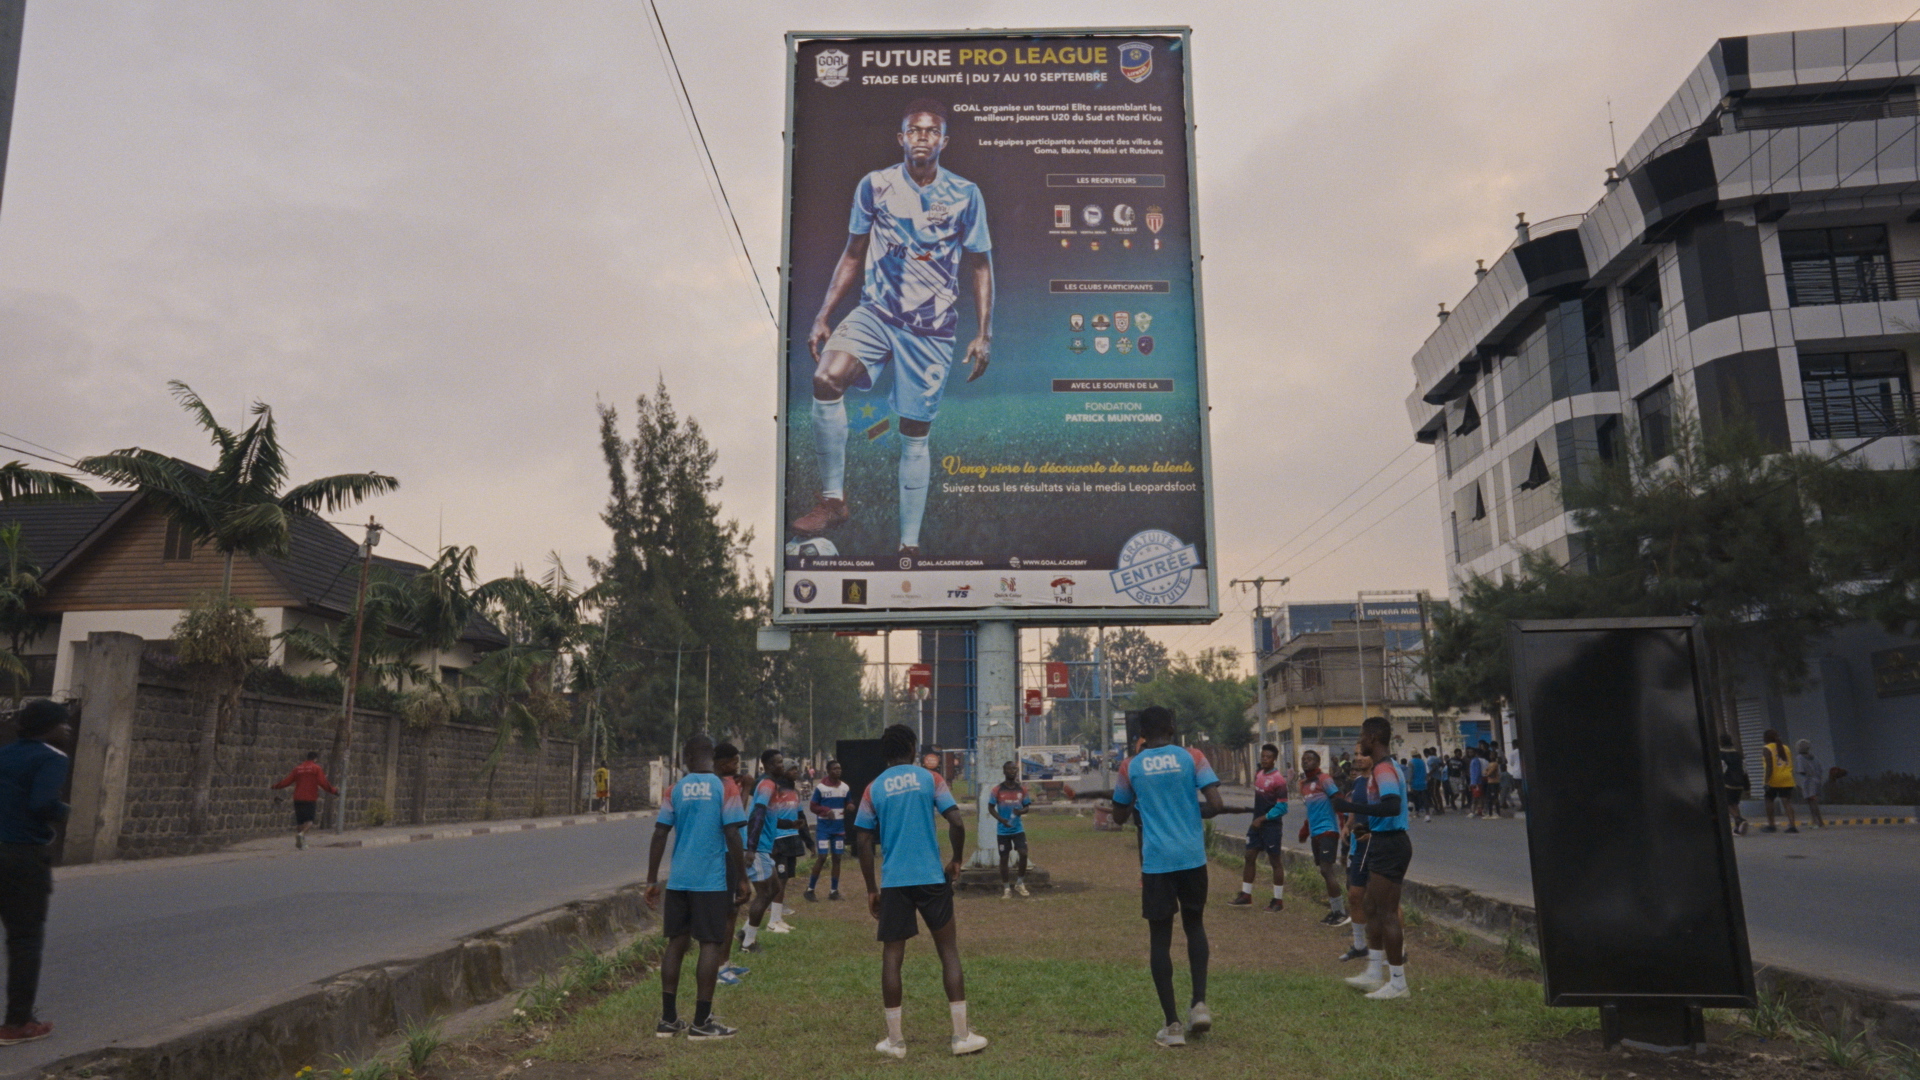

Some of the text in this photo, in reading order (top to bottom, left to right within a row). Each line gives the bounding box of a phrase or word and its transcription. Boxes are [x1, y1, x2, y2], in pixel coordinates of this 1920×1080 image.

[818, 55, 846, 66] GOAL
[861, 47, 1108, 67] FUTURE PRO LEAGUE
[862, 75, 899, 85] STADE
[902, 74, 917, 84] DE
[921, 72, 963, 83] L'UNITÉ
[972, 73, 990, 82] DU
[993, 73, 1000, 83] 7
[1003, 73, 1020, 82] AU
[1024, 72, 1037, 82] 10
[1040, 72, 1108, 82] SEPTEMBRE
[953, 104, 980, 112] GOAL
[983, 104, 1020, 114] organise
[1036, 103, 1069, 111] tournoi
[1071, 103, 1091, 111] Elite
[1093, 103, 1147, 111] rassemblant
[1149, 103, 1162, 111] les
[974, 114, 1014, 122] meilleurs
[1016, 113, 1049, 123] joueurs
[1051, 113, 1070, 121] U20
[1072, 113, 1083, 121] du
[1086, 113, 1102, 121] Sud
[1117, 113, 1140, 121] Nord
[1142, 113, 1162, 121] Kivu
[1025, 138, 1075, 147] participantes
[1033, 147, 1059, 155] Goma,
[1061, 147, 1091, 155] Bukavu,
[1129, 147, 1163, 155] Rutshuru
[887, 243, 909, 260] TVS
[1085, 402, 1142, 411] FONDATION
[1065, 414, 1162, 422] PATRICK MUNYOMO
[942, 455, 1195, 479] Venez vivre la découverte de nos talents
[942, 481, 1196, 494] Suivez tous les résultats via le media Leopardsfoot
[1120, 552, 1190, 586] ENTRÉE
[947, 590, 969, 598] TVS
[1135, 576, 1189, 605] GRATUITE
[1054, 596, 1073, 604] TMB
[1367, 608, 1399, 616] RIVIERA
[1143, 754, 1181, 771] GOAL
[884, 772, 920, 792] GOAL
[682, 782, 712, 797] GOAL
